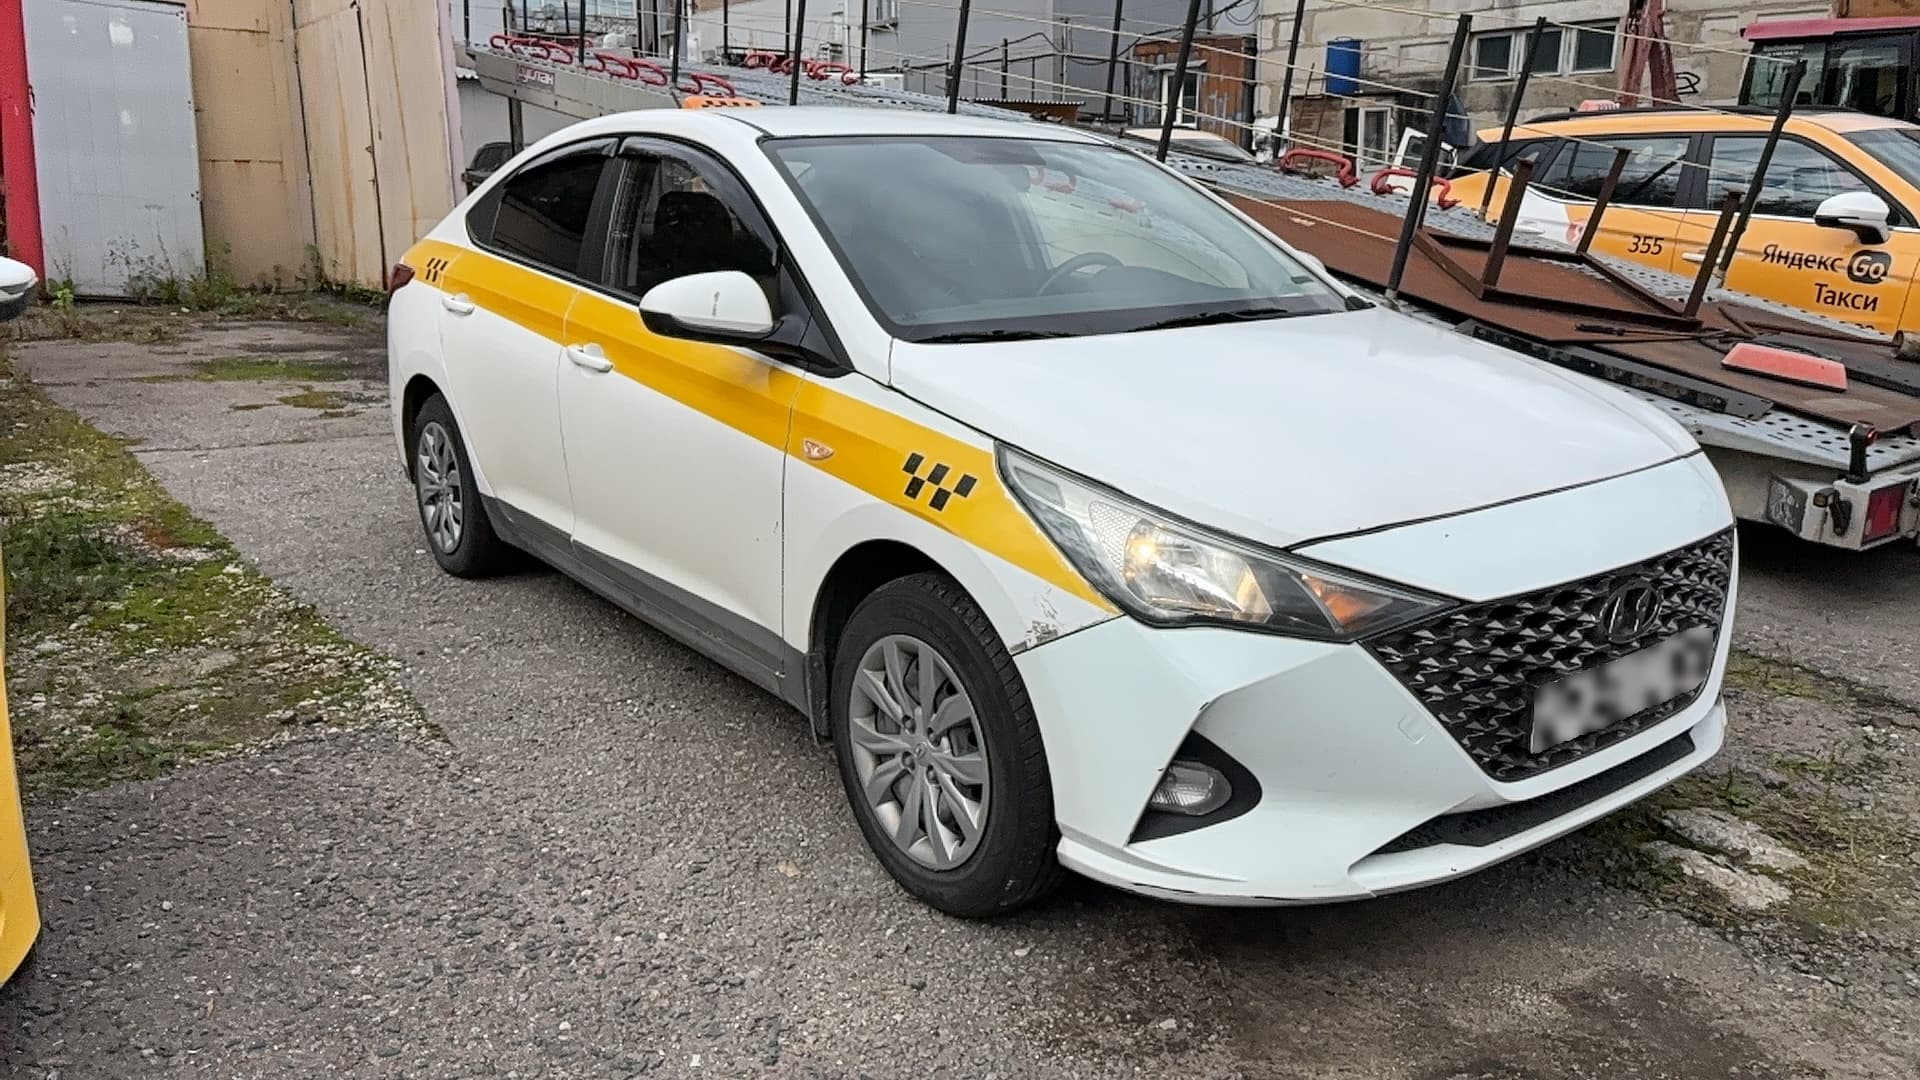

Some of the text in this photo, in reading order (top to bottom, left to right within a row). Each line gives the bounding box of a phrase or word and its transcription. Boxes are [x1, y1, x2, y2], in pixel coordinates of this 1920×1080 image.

[1628, 234, 1665, 256] 355
[1762, 244, 1887, 281] Яндекс Go
[1814, 282, 1879, 312] Такси
